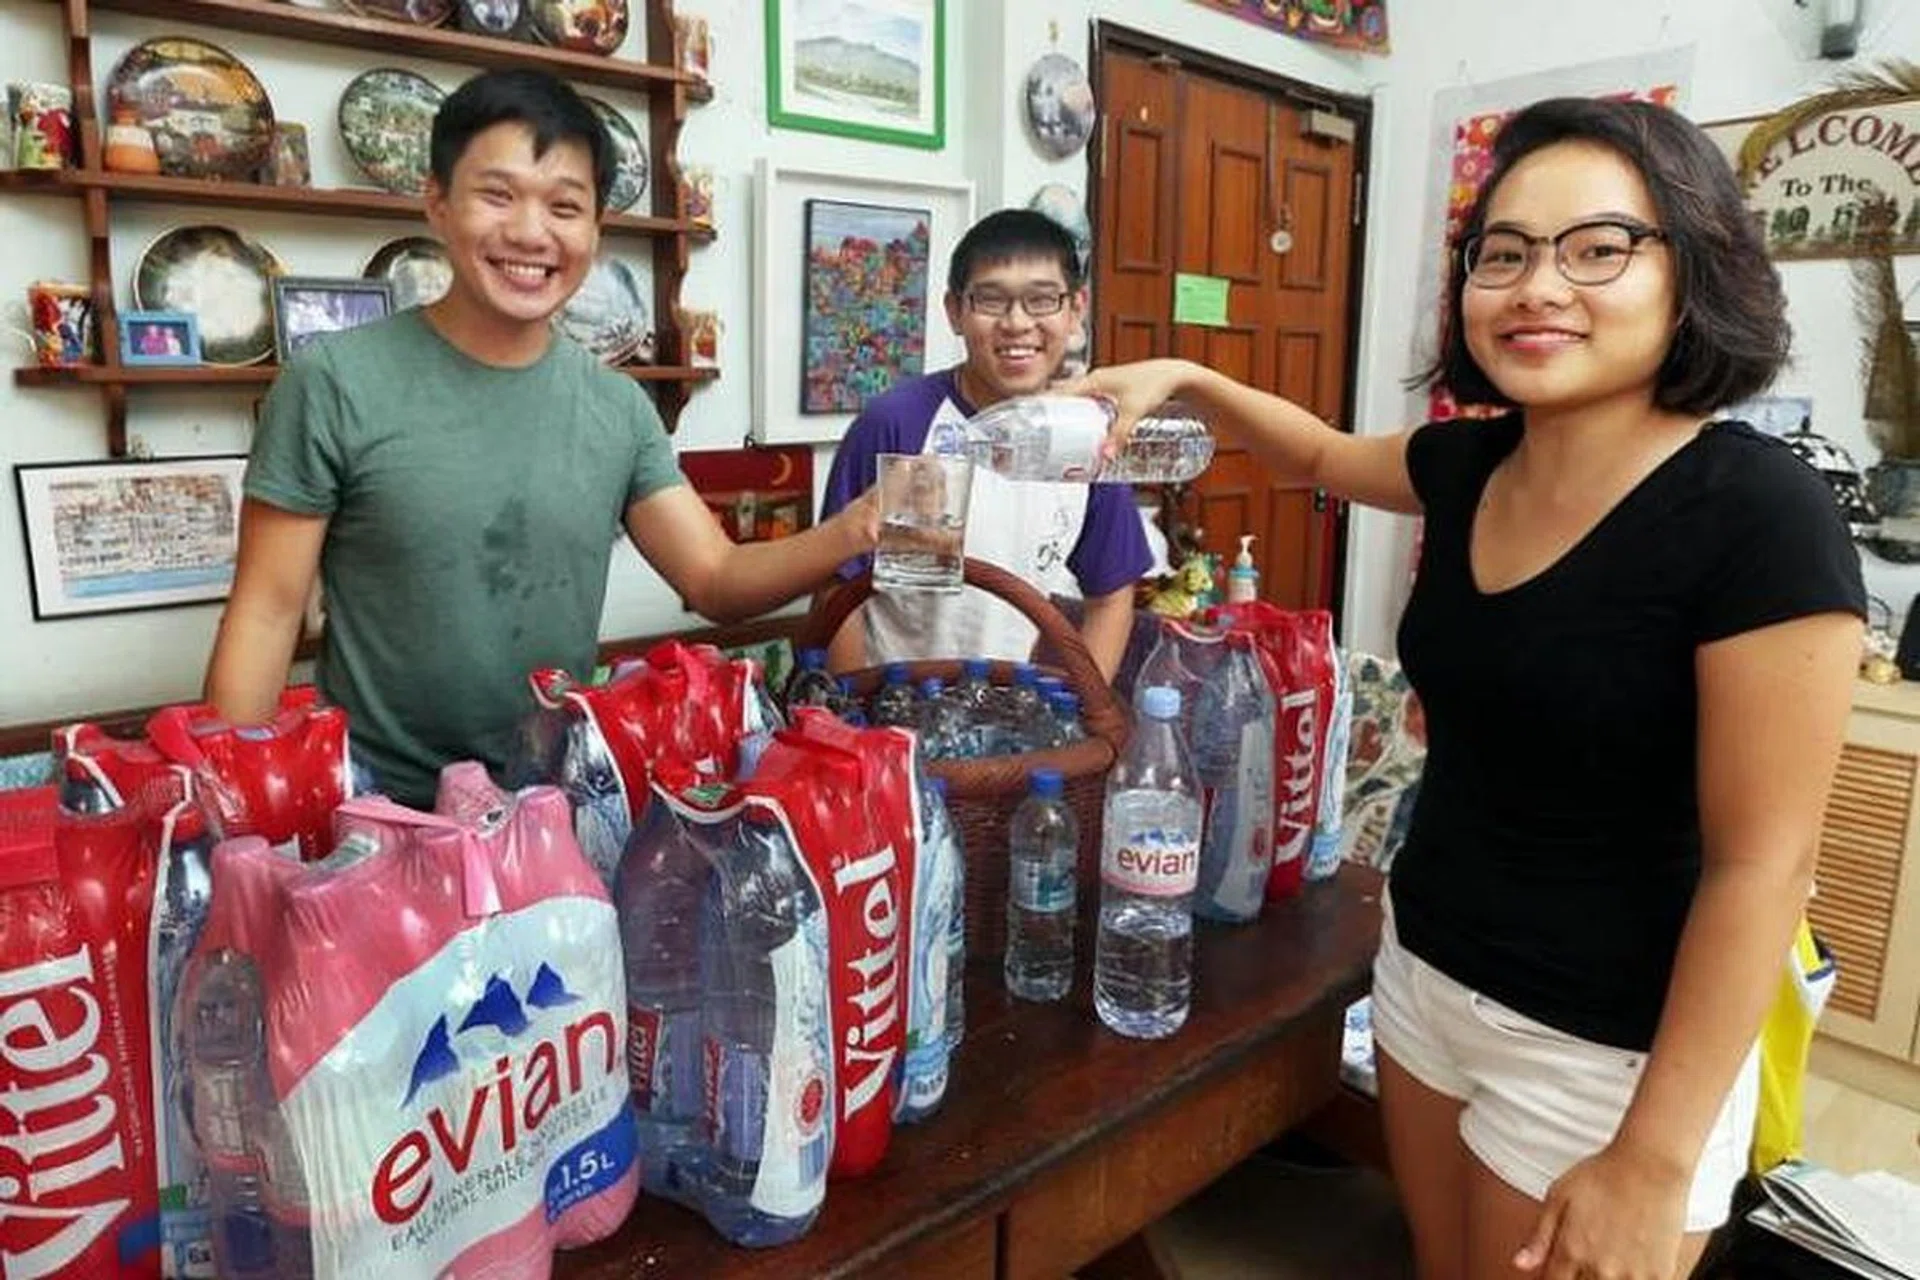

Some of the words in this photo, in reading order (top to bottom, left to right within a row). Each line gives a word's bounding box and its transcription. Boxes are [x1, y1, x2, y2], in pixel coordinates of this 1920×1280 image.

[1737, 115, 1920, 188] ELCOM
[1779, 178, 1812, 197] To
[1820, 173, 1872, 195] The
[1118, 847, 1195, 875] evian
[372, 1011, 616, 1225] evian
